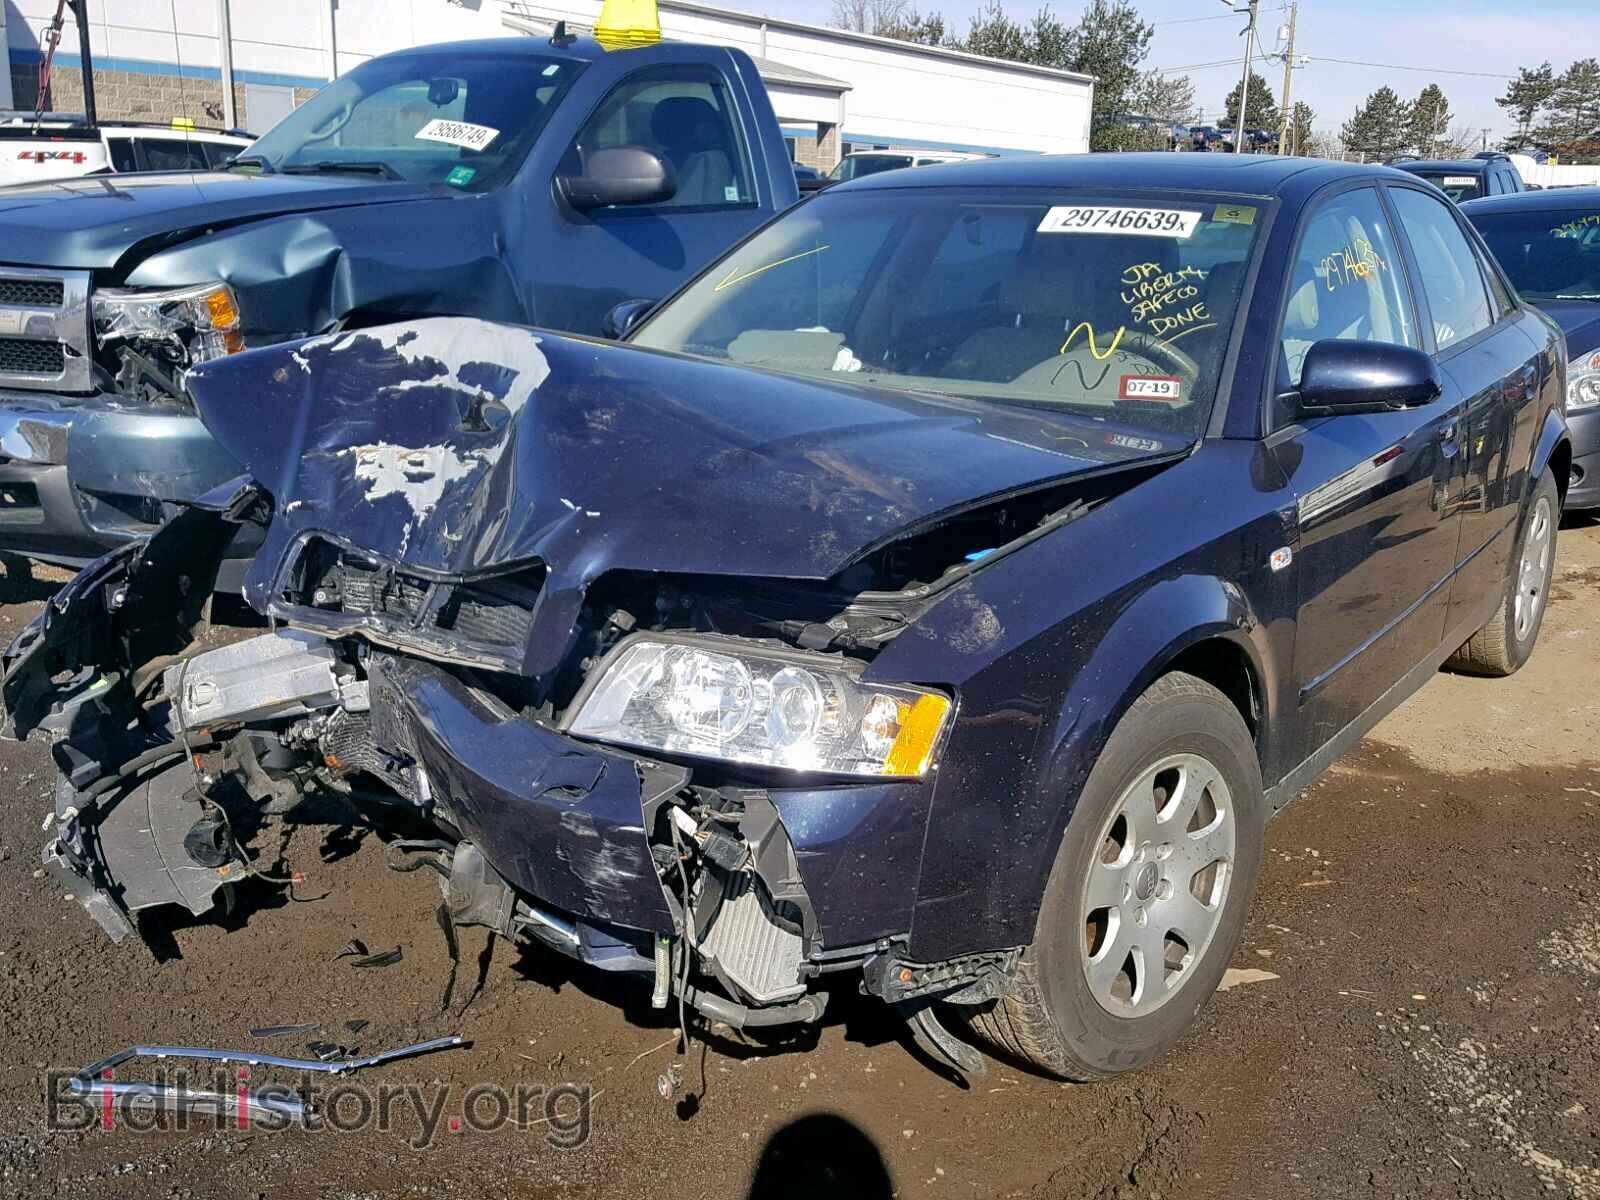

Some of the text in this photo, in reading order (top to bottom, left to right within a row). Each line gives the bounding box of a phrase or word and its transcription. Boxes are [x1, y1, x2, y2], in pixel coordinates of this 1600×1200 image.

[1131, 285, 1198, 323] SAFECO
[1147, 302, 1211, 336] DONE
[1127, 381, 1171, 395] 07-19
